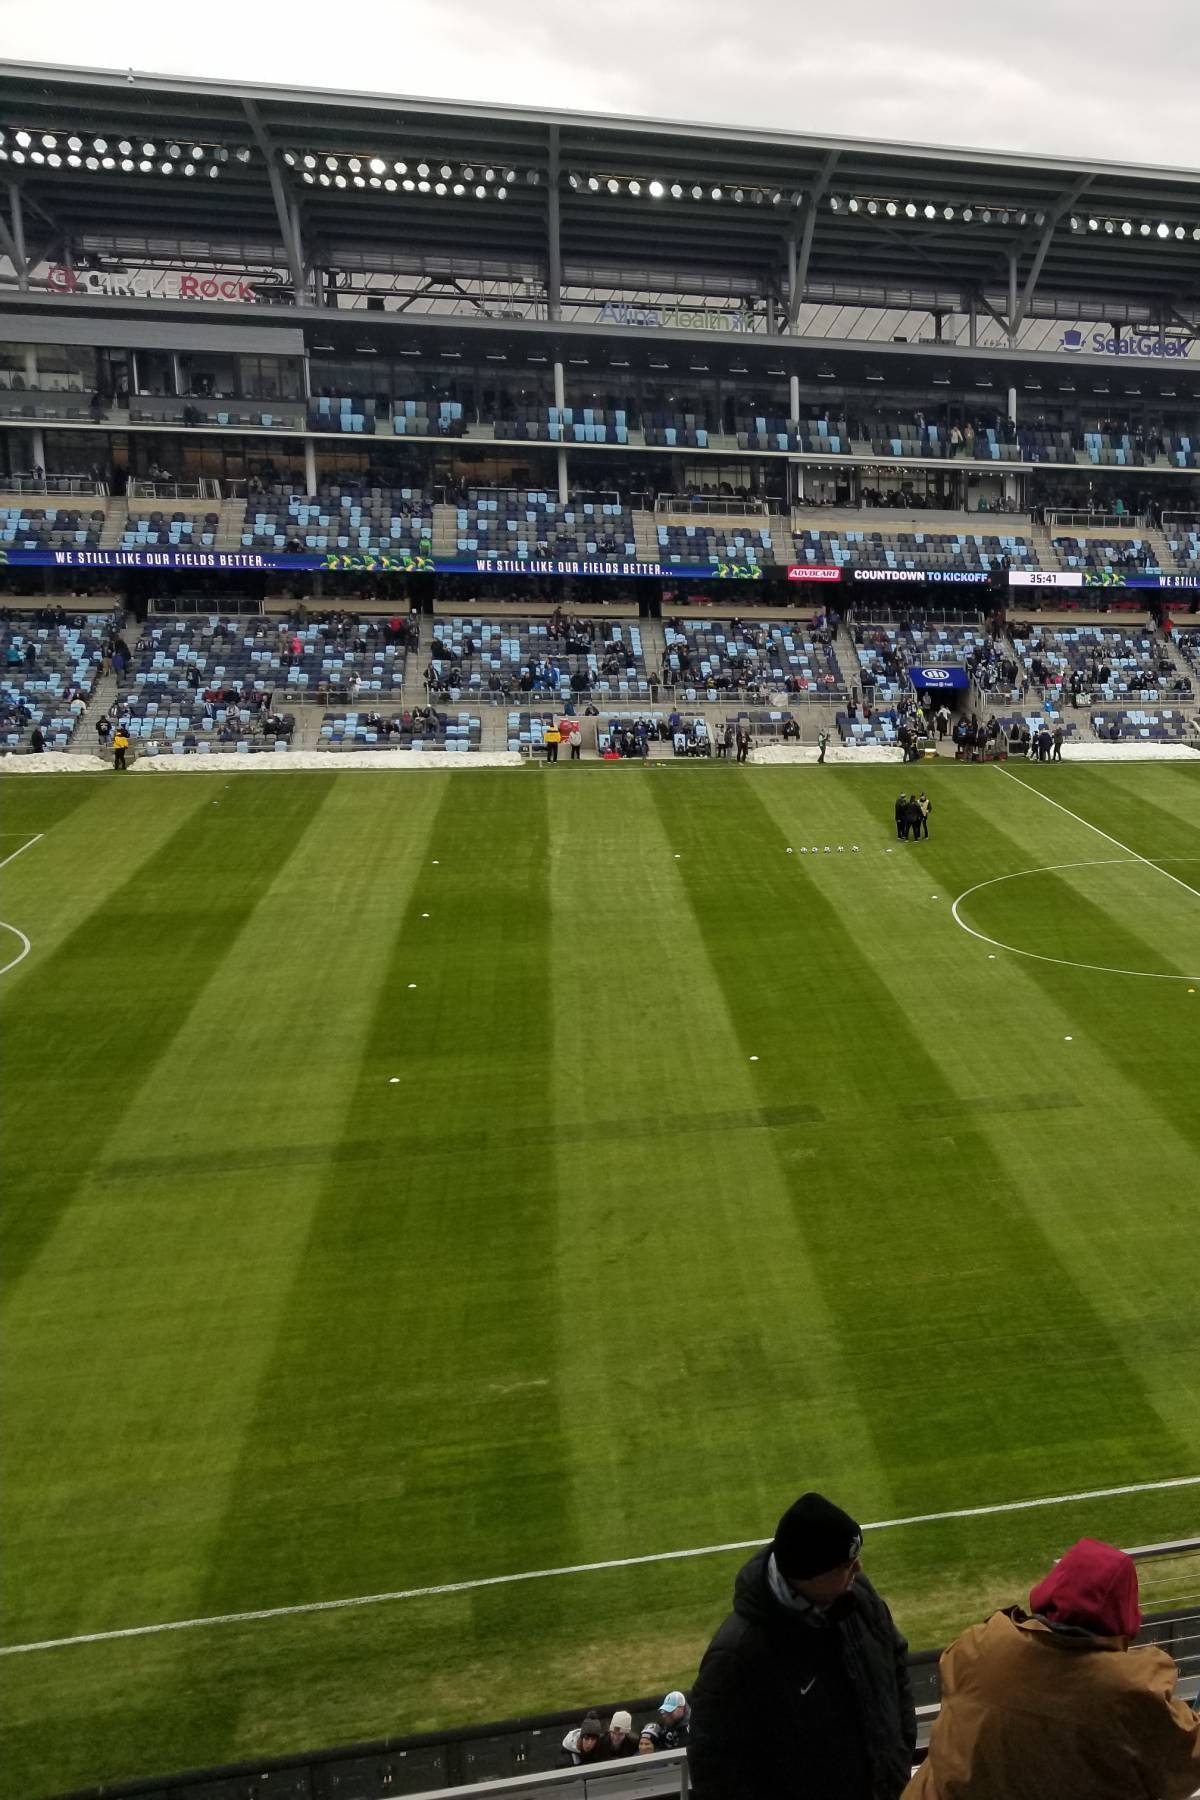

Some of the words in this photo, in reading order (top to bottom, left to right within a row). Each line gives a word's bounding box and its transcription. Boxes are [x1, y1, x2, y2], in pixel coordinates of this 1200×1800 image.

[1092, 333, 1189, 358] SeatGeek
[55, 552, 72, 564] WE
[78, 552, 110, 564] STILL
[116, 553, 141, 565] LIKE
[146, 553, 170, 565] OUR
[175, 553, 215, 566] FIELDS
[220, 554, 276, 567] BETTER...
[476, 560, 492, 571] WE
[496, 560, 526, 572] STILL
[530, 561, 553, 573] LIKE
[558, 561, 579, 573] OUR
[583, 562, 618, 574] FIELDS
[623, 563, 673, 575] BETTER...
[790, 569, 838, 579] ADVOCARE
[854, 570, 925, 581] COUNTDOWN
[927, 571, 941, 581] TO
[942, 572, 988, 583] KICKOFF
[1029, 574, 1057, 584] 35:41
[1159, 576, 1171, 586] WE
[1174, 576, 1198, 587] STILL
